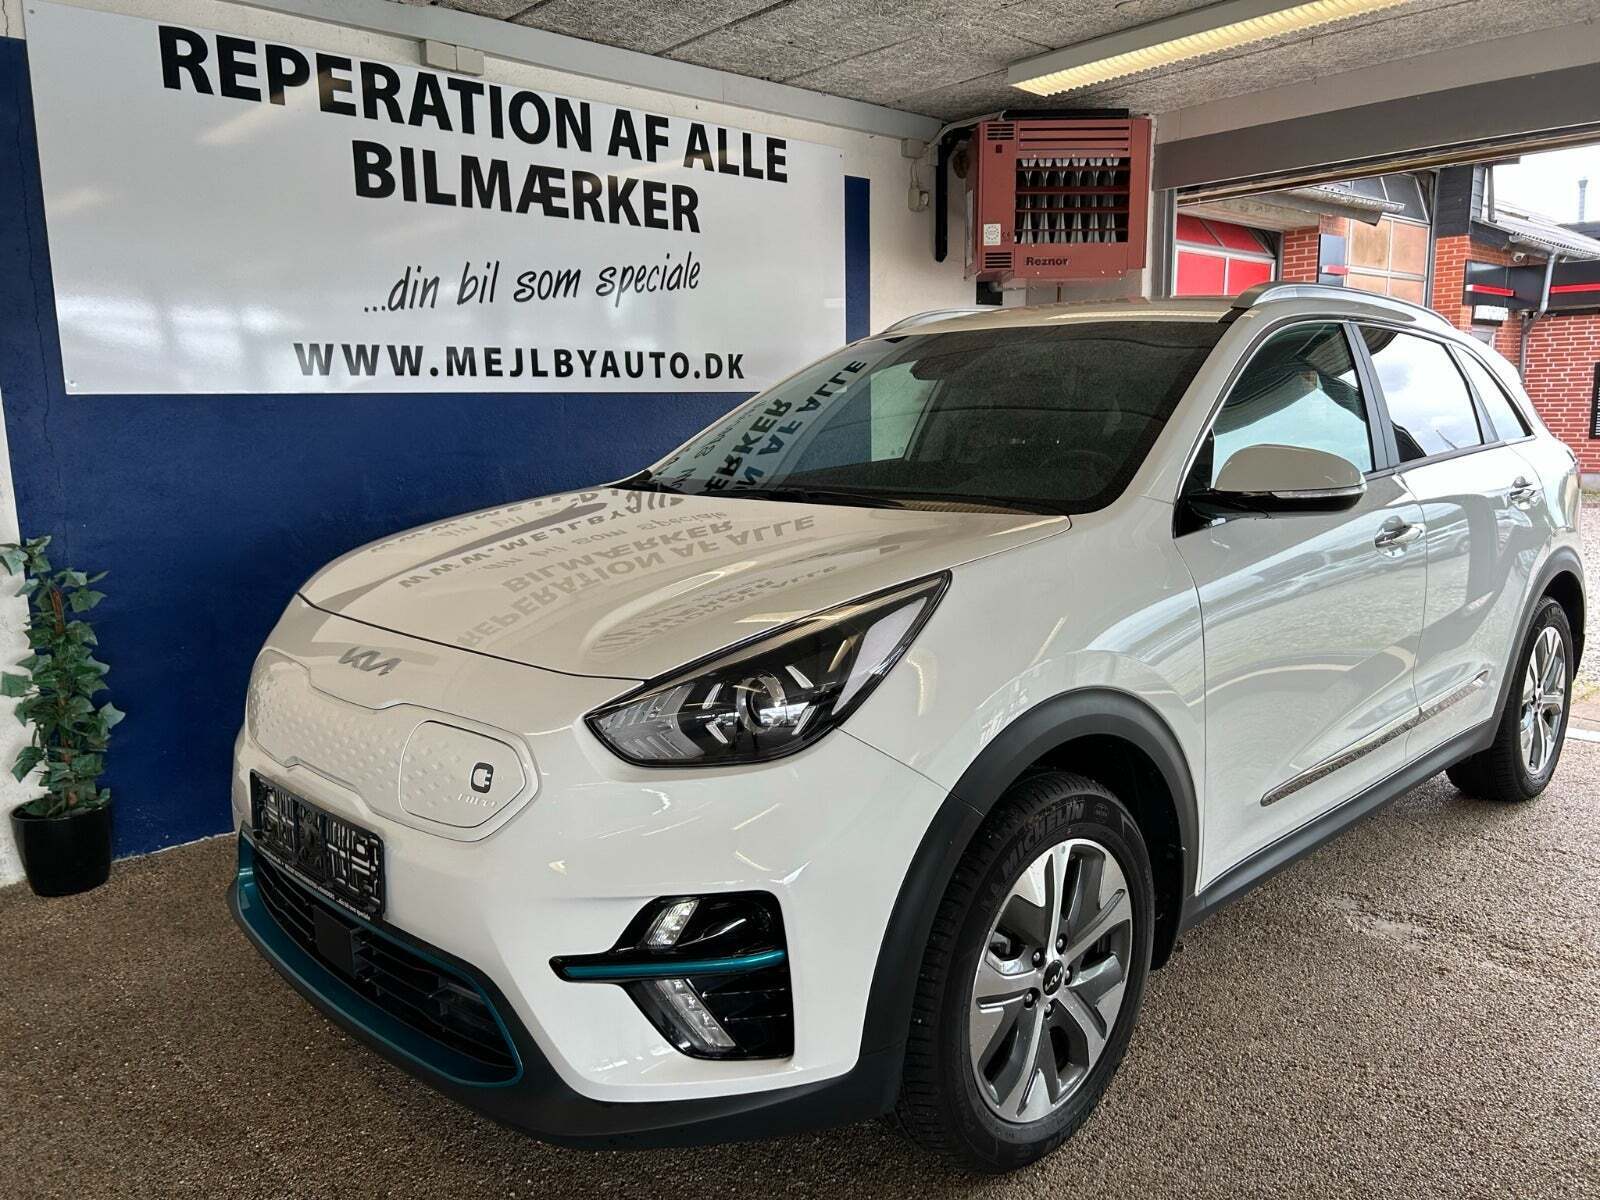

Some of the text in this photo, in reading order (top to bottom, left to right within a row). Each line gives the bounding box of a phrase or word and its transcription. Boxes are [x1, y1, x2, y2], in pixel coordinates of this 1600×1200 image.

[159, 25, 788, 183] REPERATION AF ALLE
[352, 140, 700, 234] BILMÆRKER
[365, 251, 701, 312] ...din bil som speciale
[1026, 256, 1068, 266] Reznor
[294, 343, 745, 380] WWW.MEJLBYAUTO.DK
